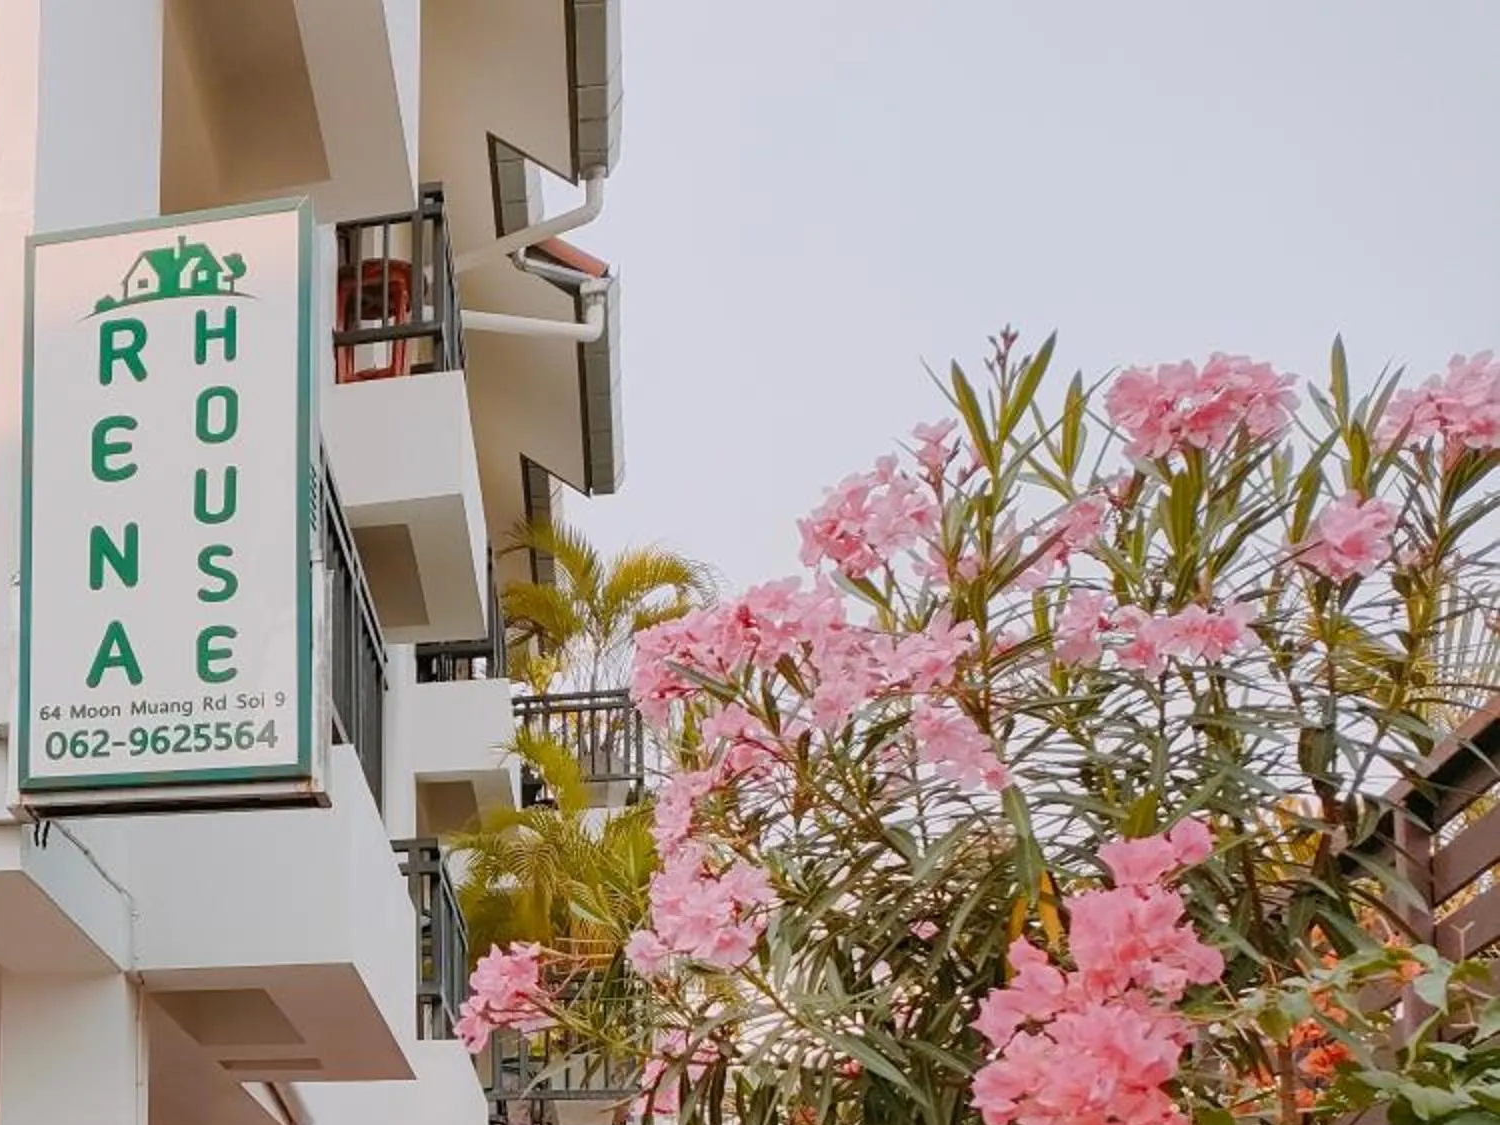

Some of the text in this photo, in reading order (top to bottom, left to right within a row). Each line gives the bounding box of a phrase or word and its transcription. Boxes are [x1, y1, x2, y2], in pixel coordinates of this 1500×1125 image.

[86, 317, 148, 688] RENA
[194, 305, 238, 683] HOUSE
[39, 691, 286, 721] 64 Moon Muang Rd Soi 9
[45, 719, 278, 760] 062-9625564
